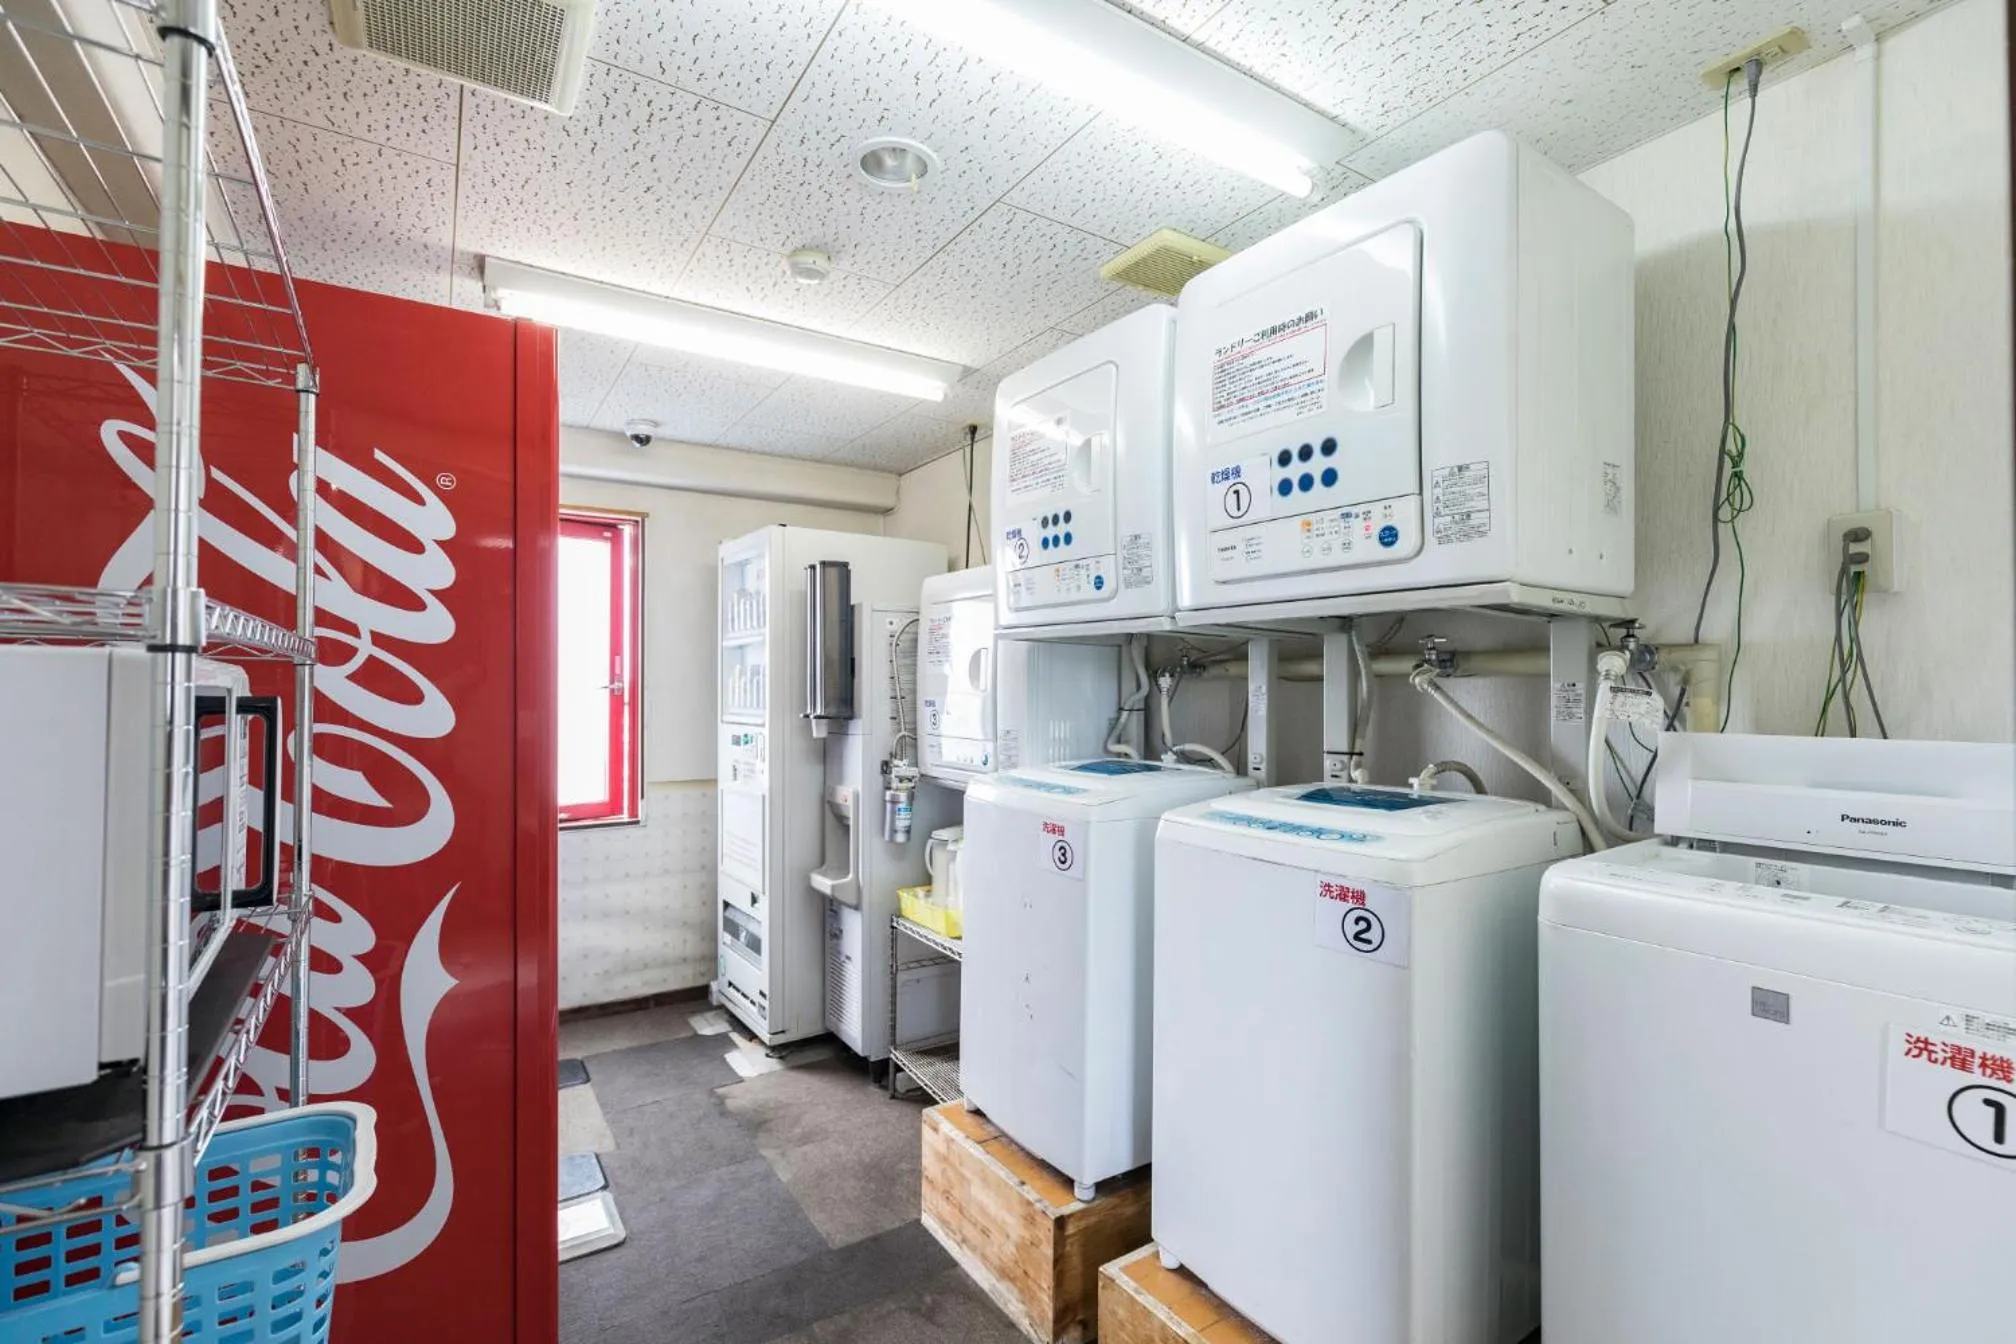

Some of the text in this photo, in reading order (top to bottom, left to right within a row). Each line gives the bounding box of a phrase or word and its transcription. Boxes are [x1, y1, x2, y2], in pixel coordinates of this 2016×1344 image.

[1840, 813, 1908, 828] Panasonic
[1319, 880, 1367, 908] 洗濯機
[1904, 1031, 2015, 1085] 洗濯機
